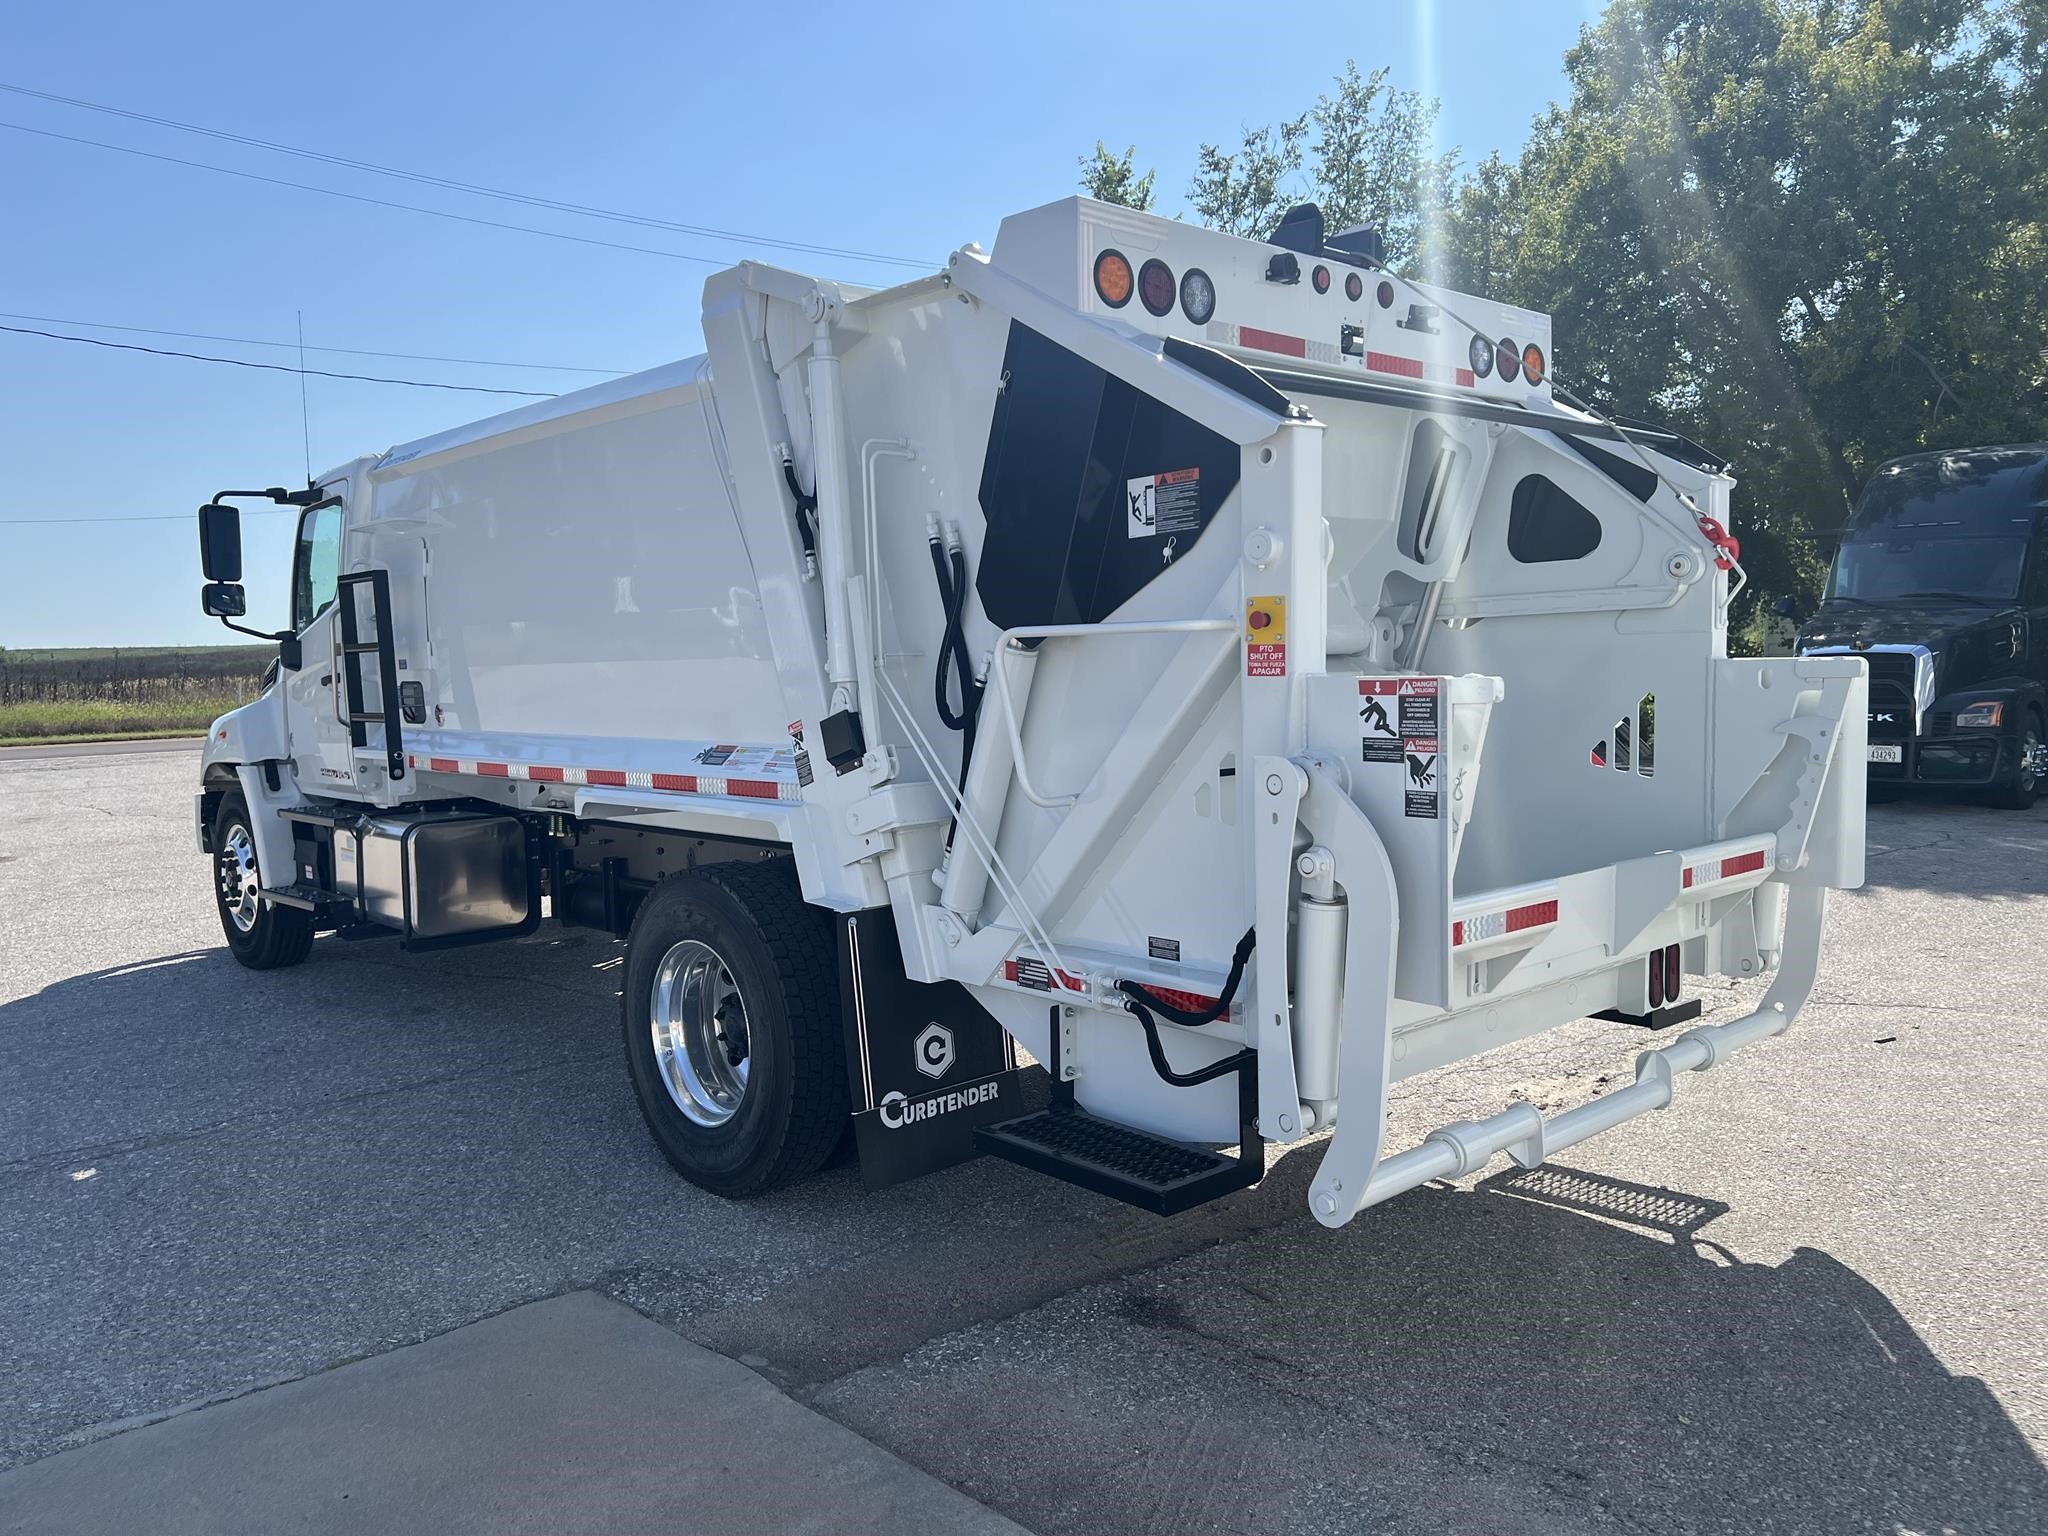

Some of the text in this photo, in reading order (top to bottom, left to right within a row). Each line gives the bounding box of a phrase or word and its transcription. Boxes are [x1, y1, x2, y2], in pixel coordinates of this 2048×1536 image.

[1252, 667, 1281, 675] APAGAR
[1872, 751, 1896, 759] 434293
[879, 1081, 999, 1129] CURBTENDER
